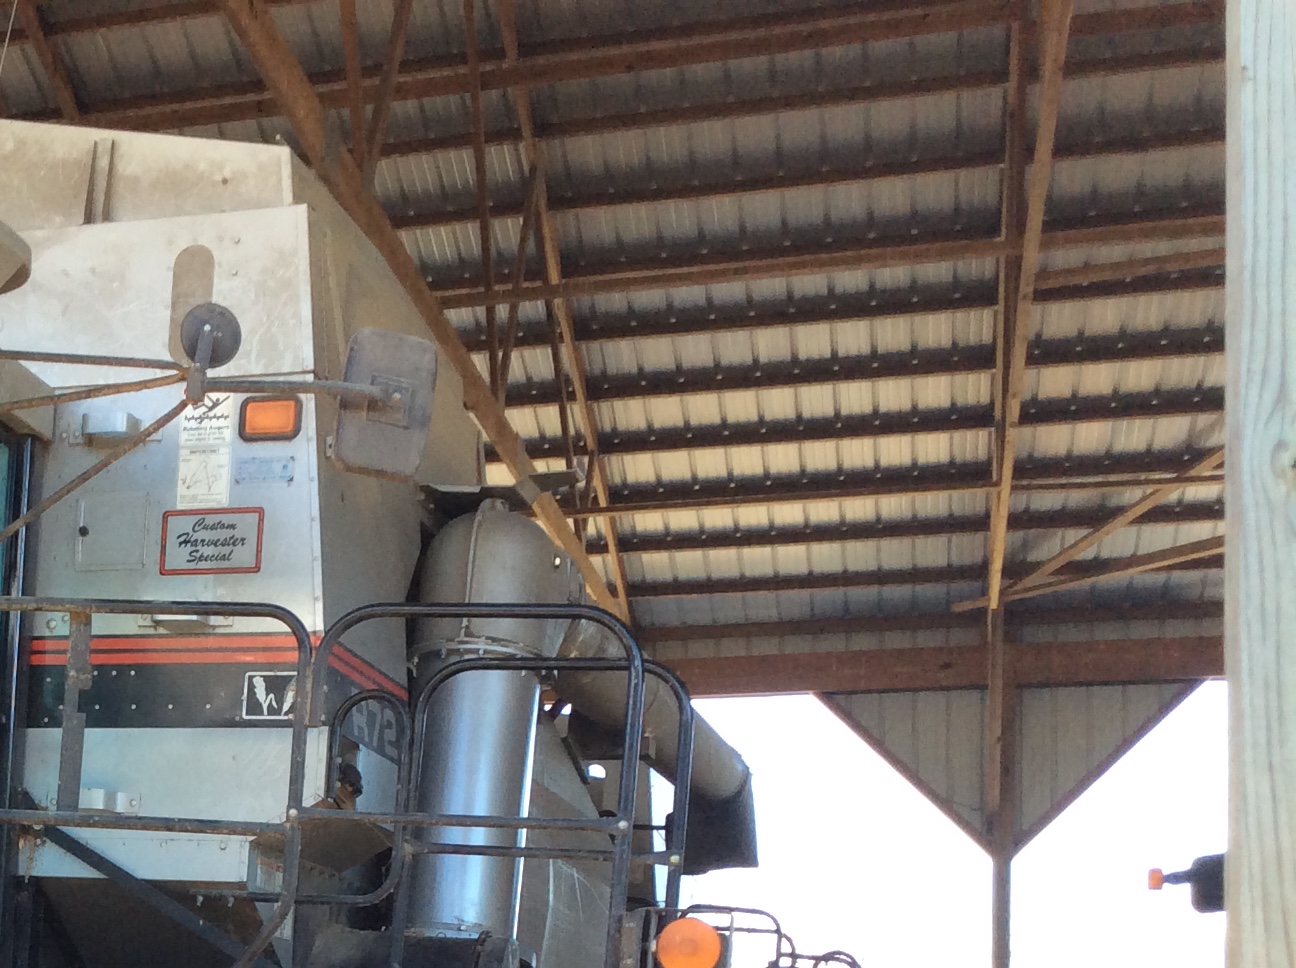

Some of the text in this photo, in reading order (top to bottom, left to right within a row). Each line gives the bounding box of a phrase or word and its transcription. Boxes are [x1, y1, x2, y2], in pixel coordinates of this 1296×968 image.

[191, 517, 238, 534] Custom
[176, 532, 247, 548] Harvester
[186, 549, 234, 566] Special
